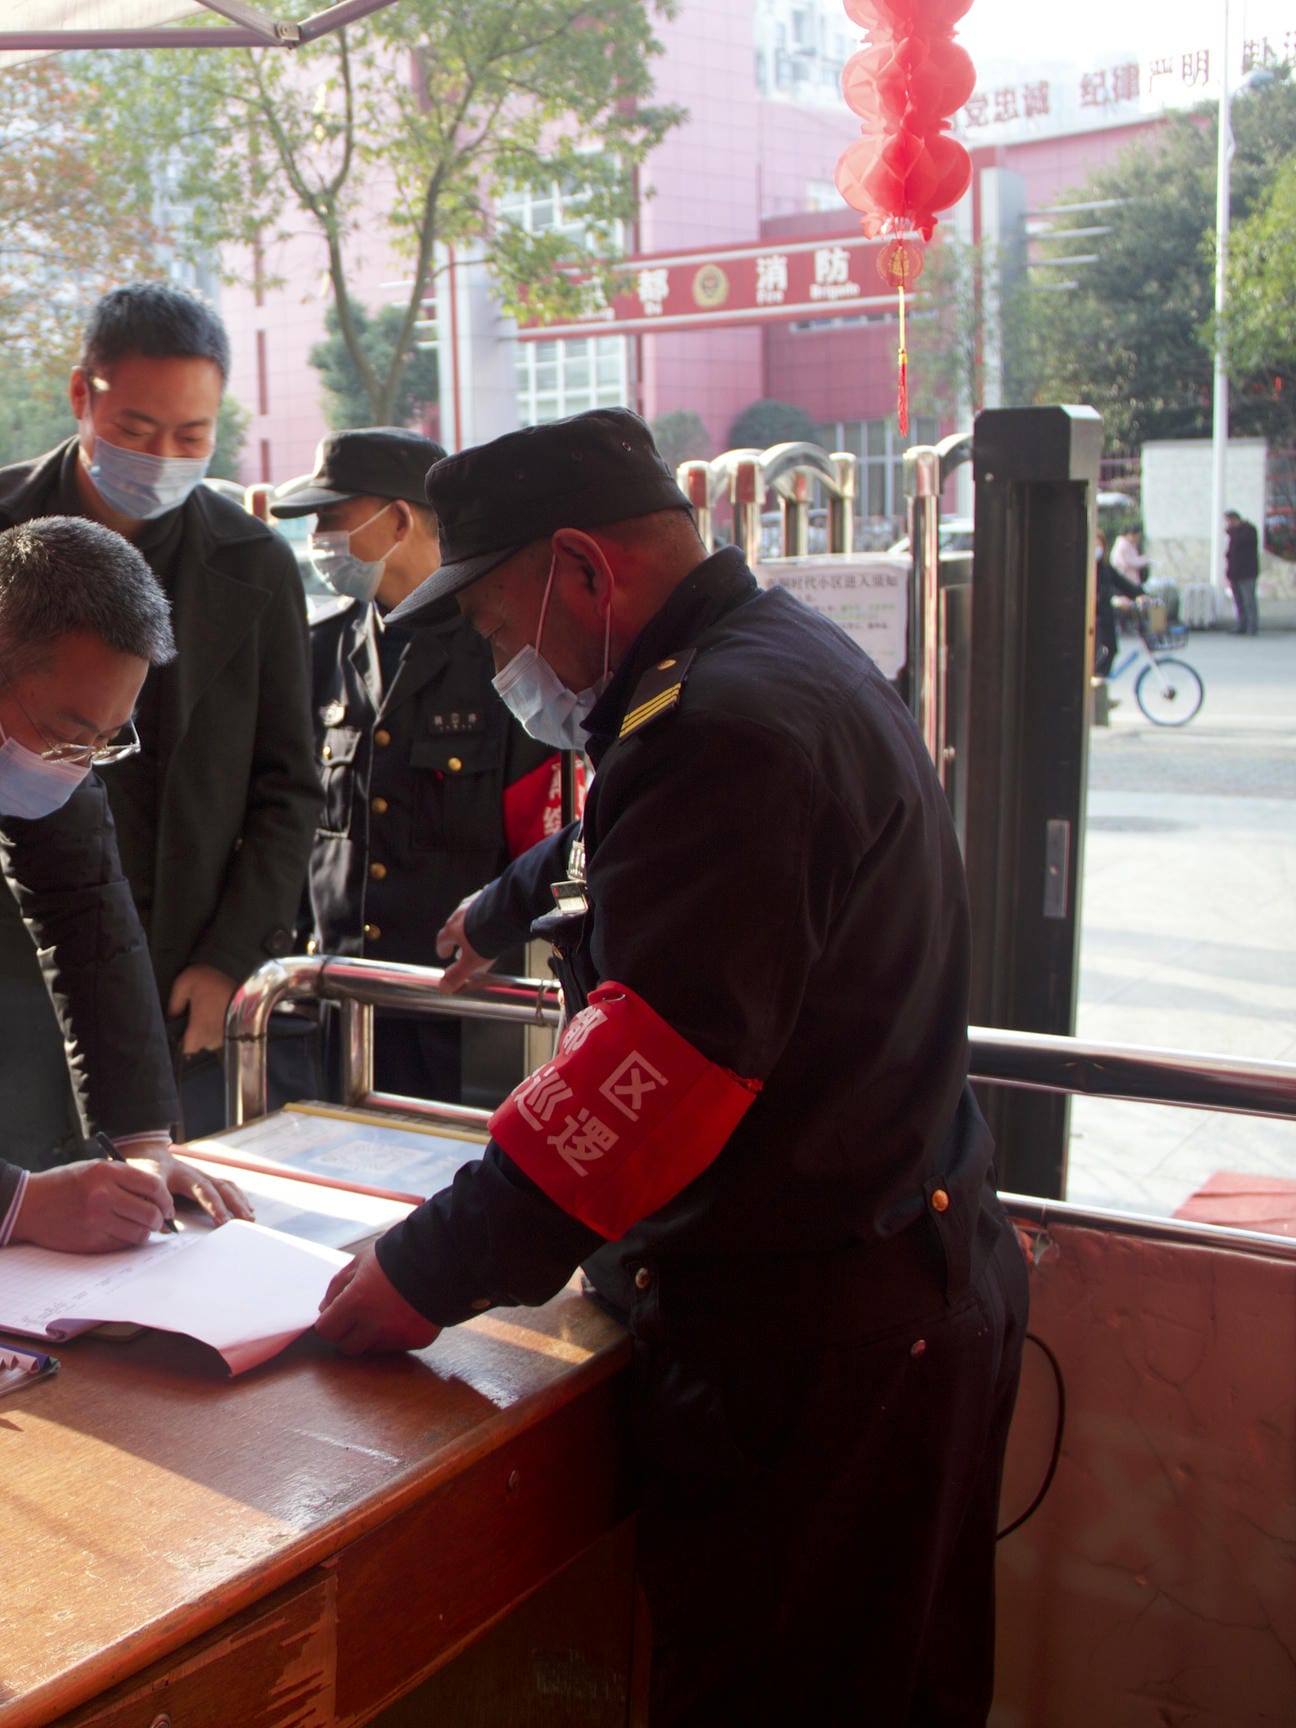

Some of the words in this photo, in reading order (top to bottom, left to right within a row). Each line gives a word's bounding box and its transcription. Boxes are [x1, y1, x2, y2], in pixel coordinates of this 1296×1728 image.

[954, 79, 1050, 130] 党忠诚
[755, 247, 851, 291] 消防
[510, 1066, 621, 1178] 巡逻
